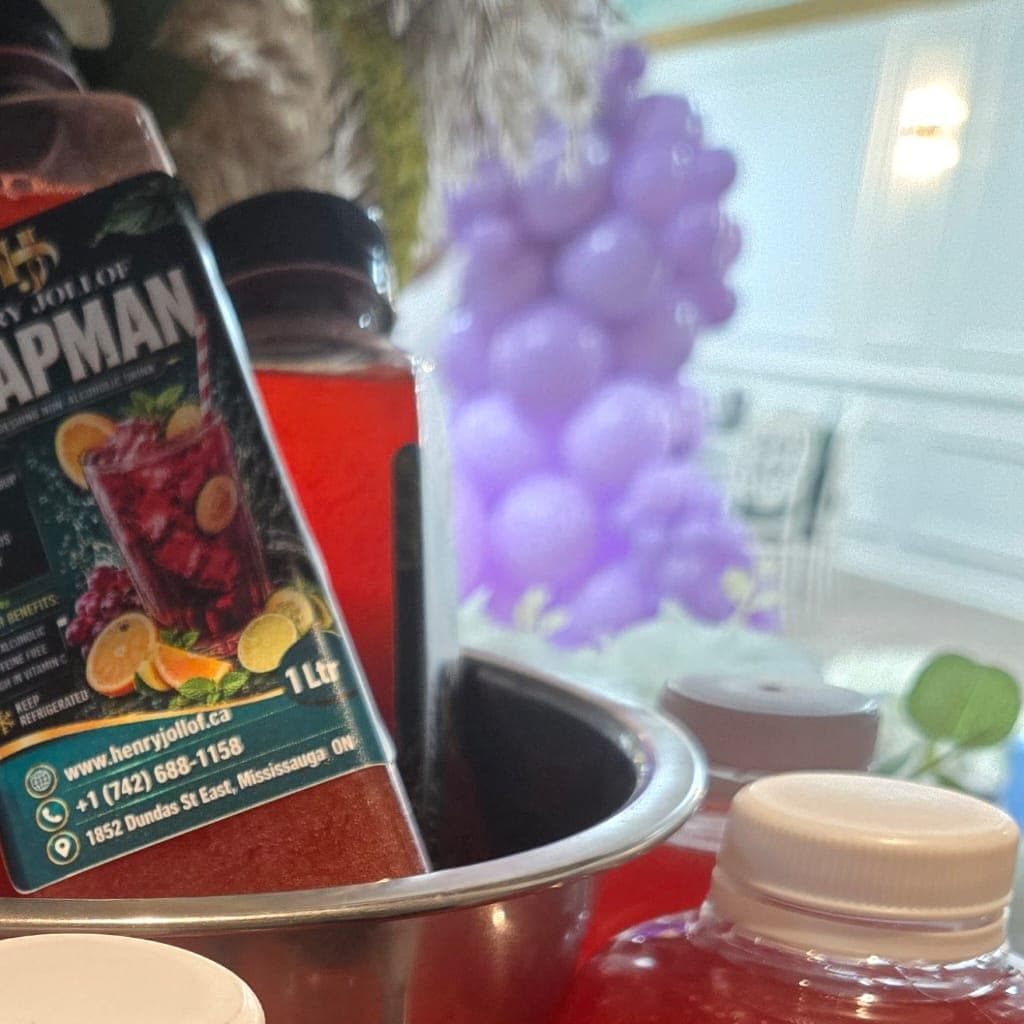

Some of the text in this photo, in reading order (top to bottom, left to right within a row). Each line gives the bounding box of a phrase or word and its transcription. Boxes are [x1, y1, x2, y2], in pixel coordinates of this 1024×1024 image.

[31, 258, 134, 314] JOLLOF
[13, 673, 23, 685] IN
[23, 655, 60, 681] VITAMIN
[61, 653, 68, 665] C
[25, 643, 49, 660] FREE
[285, 664, 303, 694] 1
[14, 693, 41, 714] KEEP
[18, 689, 90, 727] REFRIGERATED
[63, 708, 234, 783] www.henryjollof.ca
[75, 736, 245, 813] +1 (742) 688-1158
[85, 735, 356, 846] 1852 Dundas St East, Mississauga, ON
